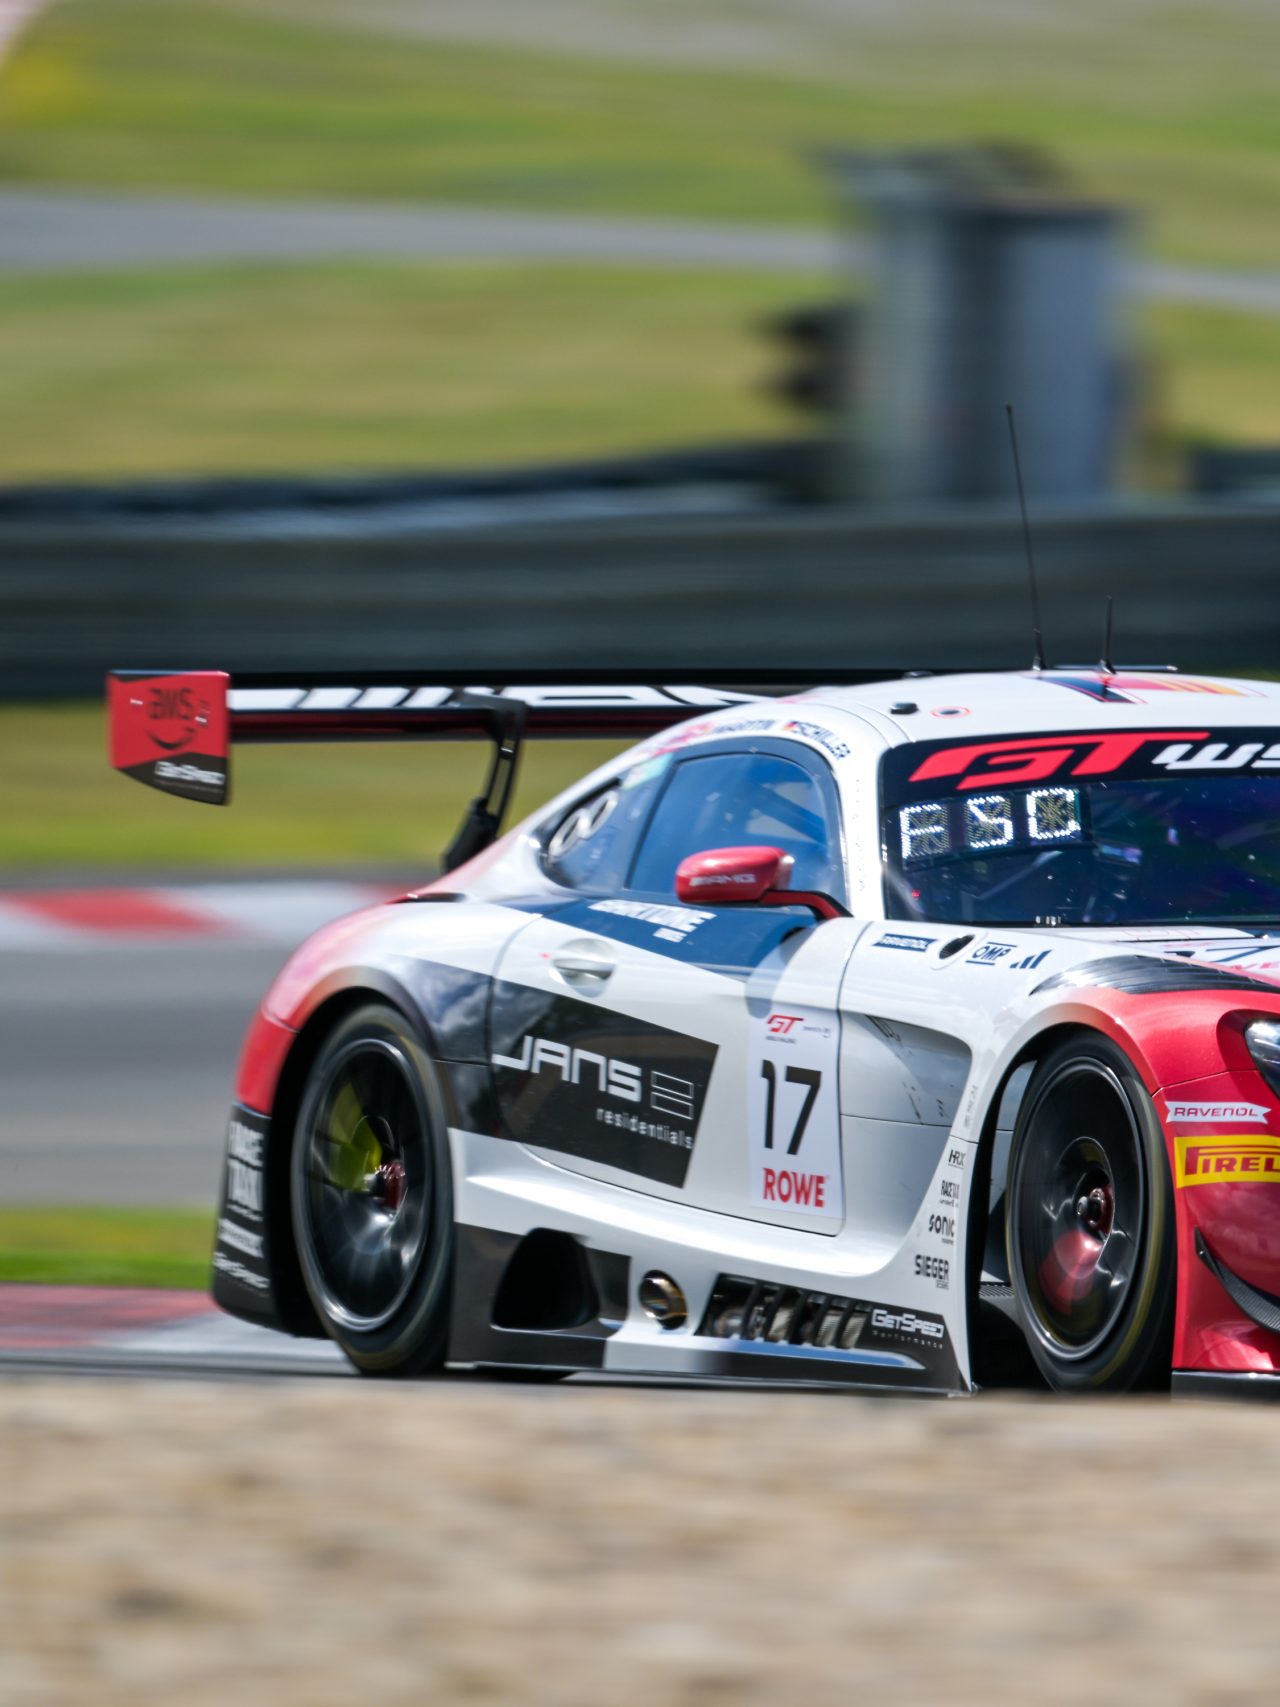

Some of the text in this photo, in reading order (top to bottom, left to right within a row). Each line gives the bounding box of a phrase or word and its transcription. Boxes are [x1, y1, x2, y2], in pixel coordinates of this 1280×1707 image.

[908, 731, 1211, 791] GT
[972, 944, 1013, 961] OMP
[766, 1014, 805, 1034] GT
[760, 1059, 822, 1156] 17
[1173, 1107, 1259, 1117] RAVENOL
[596, 1107, 694, 1150] residentials
[948, 1149, 967, 1167] HRX
[762, 1167, 826, 1208] ROWE
[928, 1213, 955, 1239] SONIC
[914, 1254, 950, 1281] SIEGER
